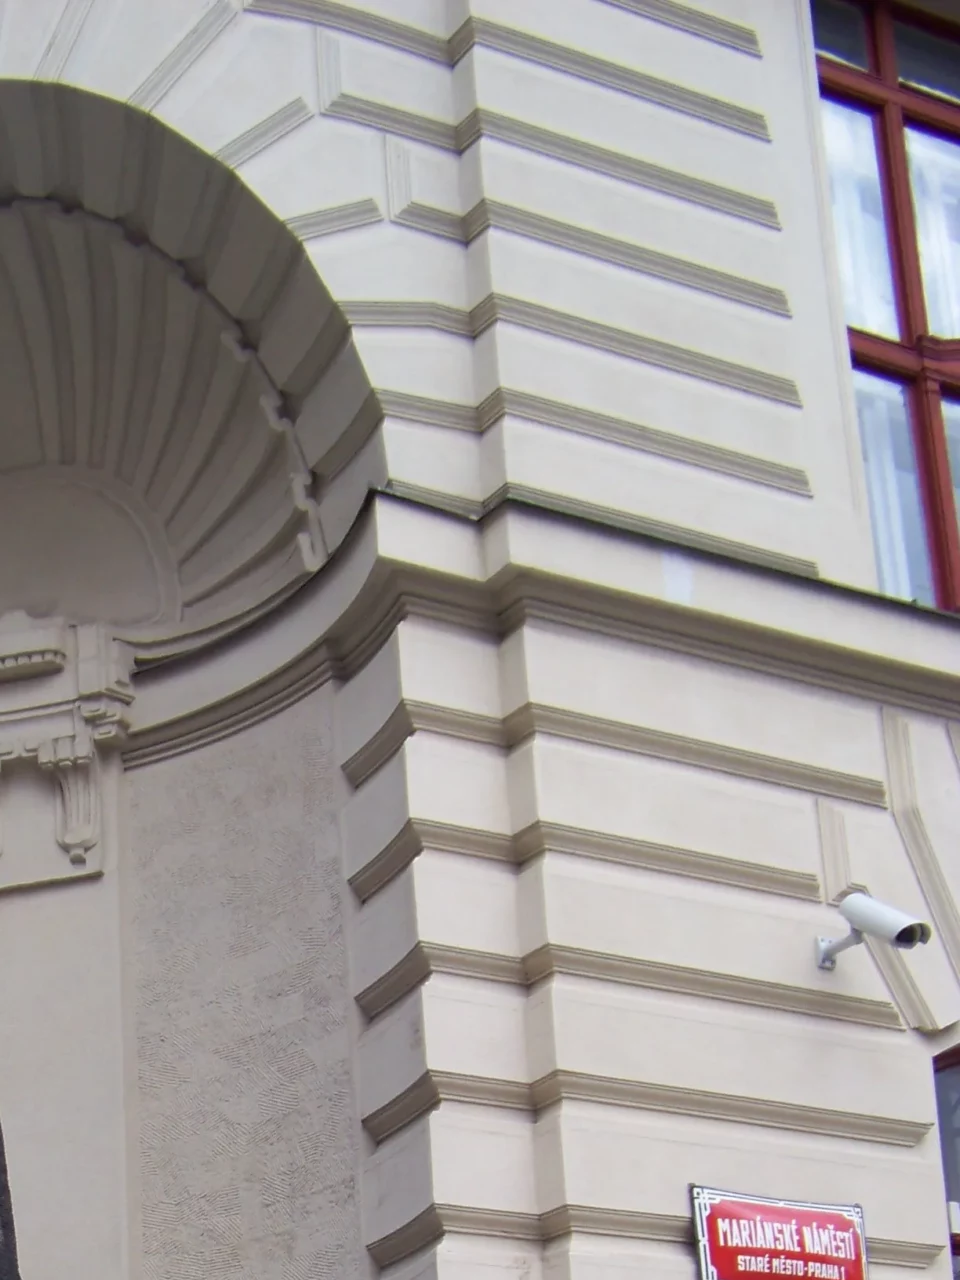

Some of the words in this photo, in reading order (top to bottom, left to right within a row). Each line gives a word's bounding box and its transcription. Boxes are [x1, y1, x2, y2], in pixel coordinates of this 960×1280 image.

[717, 1216, 801, 1252] MARIÁNSKÉ
[802, 1222, 855, 1260] NÁMĚSTÍ
[737, 1254, 770, 1273] STARÉ
[840, 1266, 845, 1280] 1
